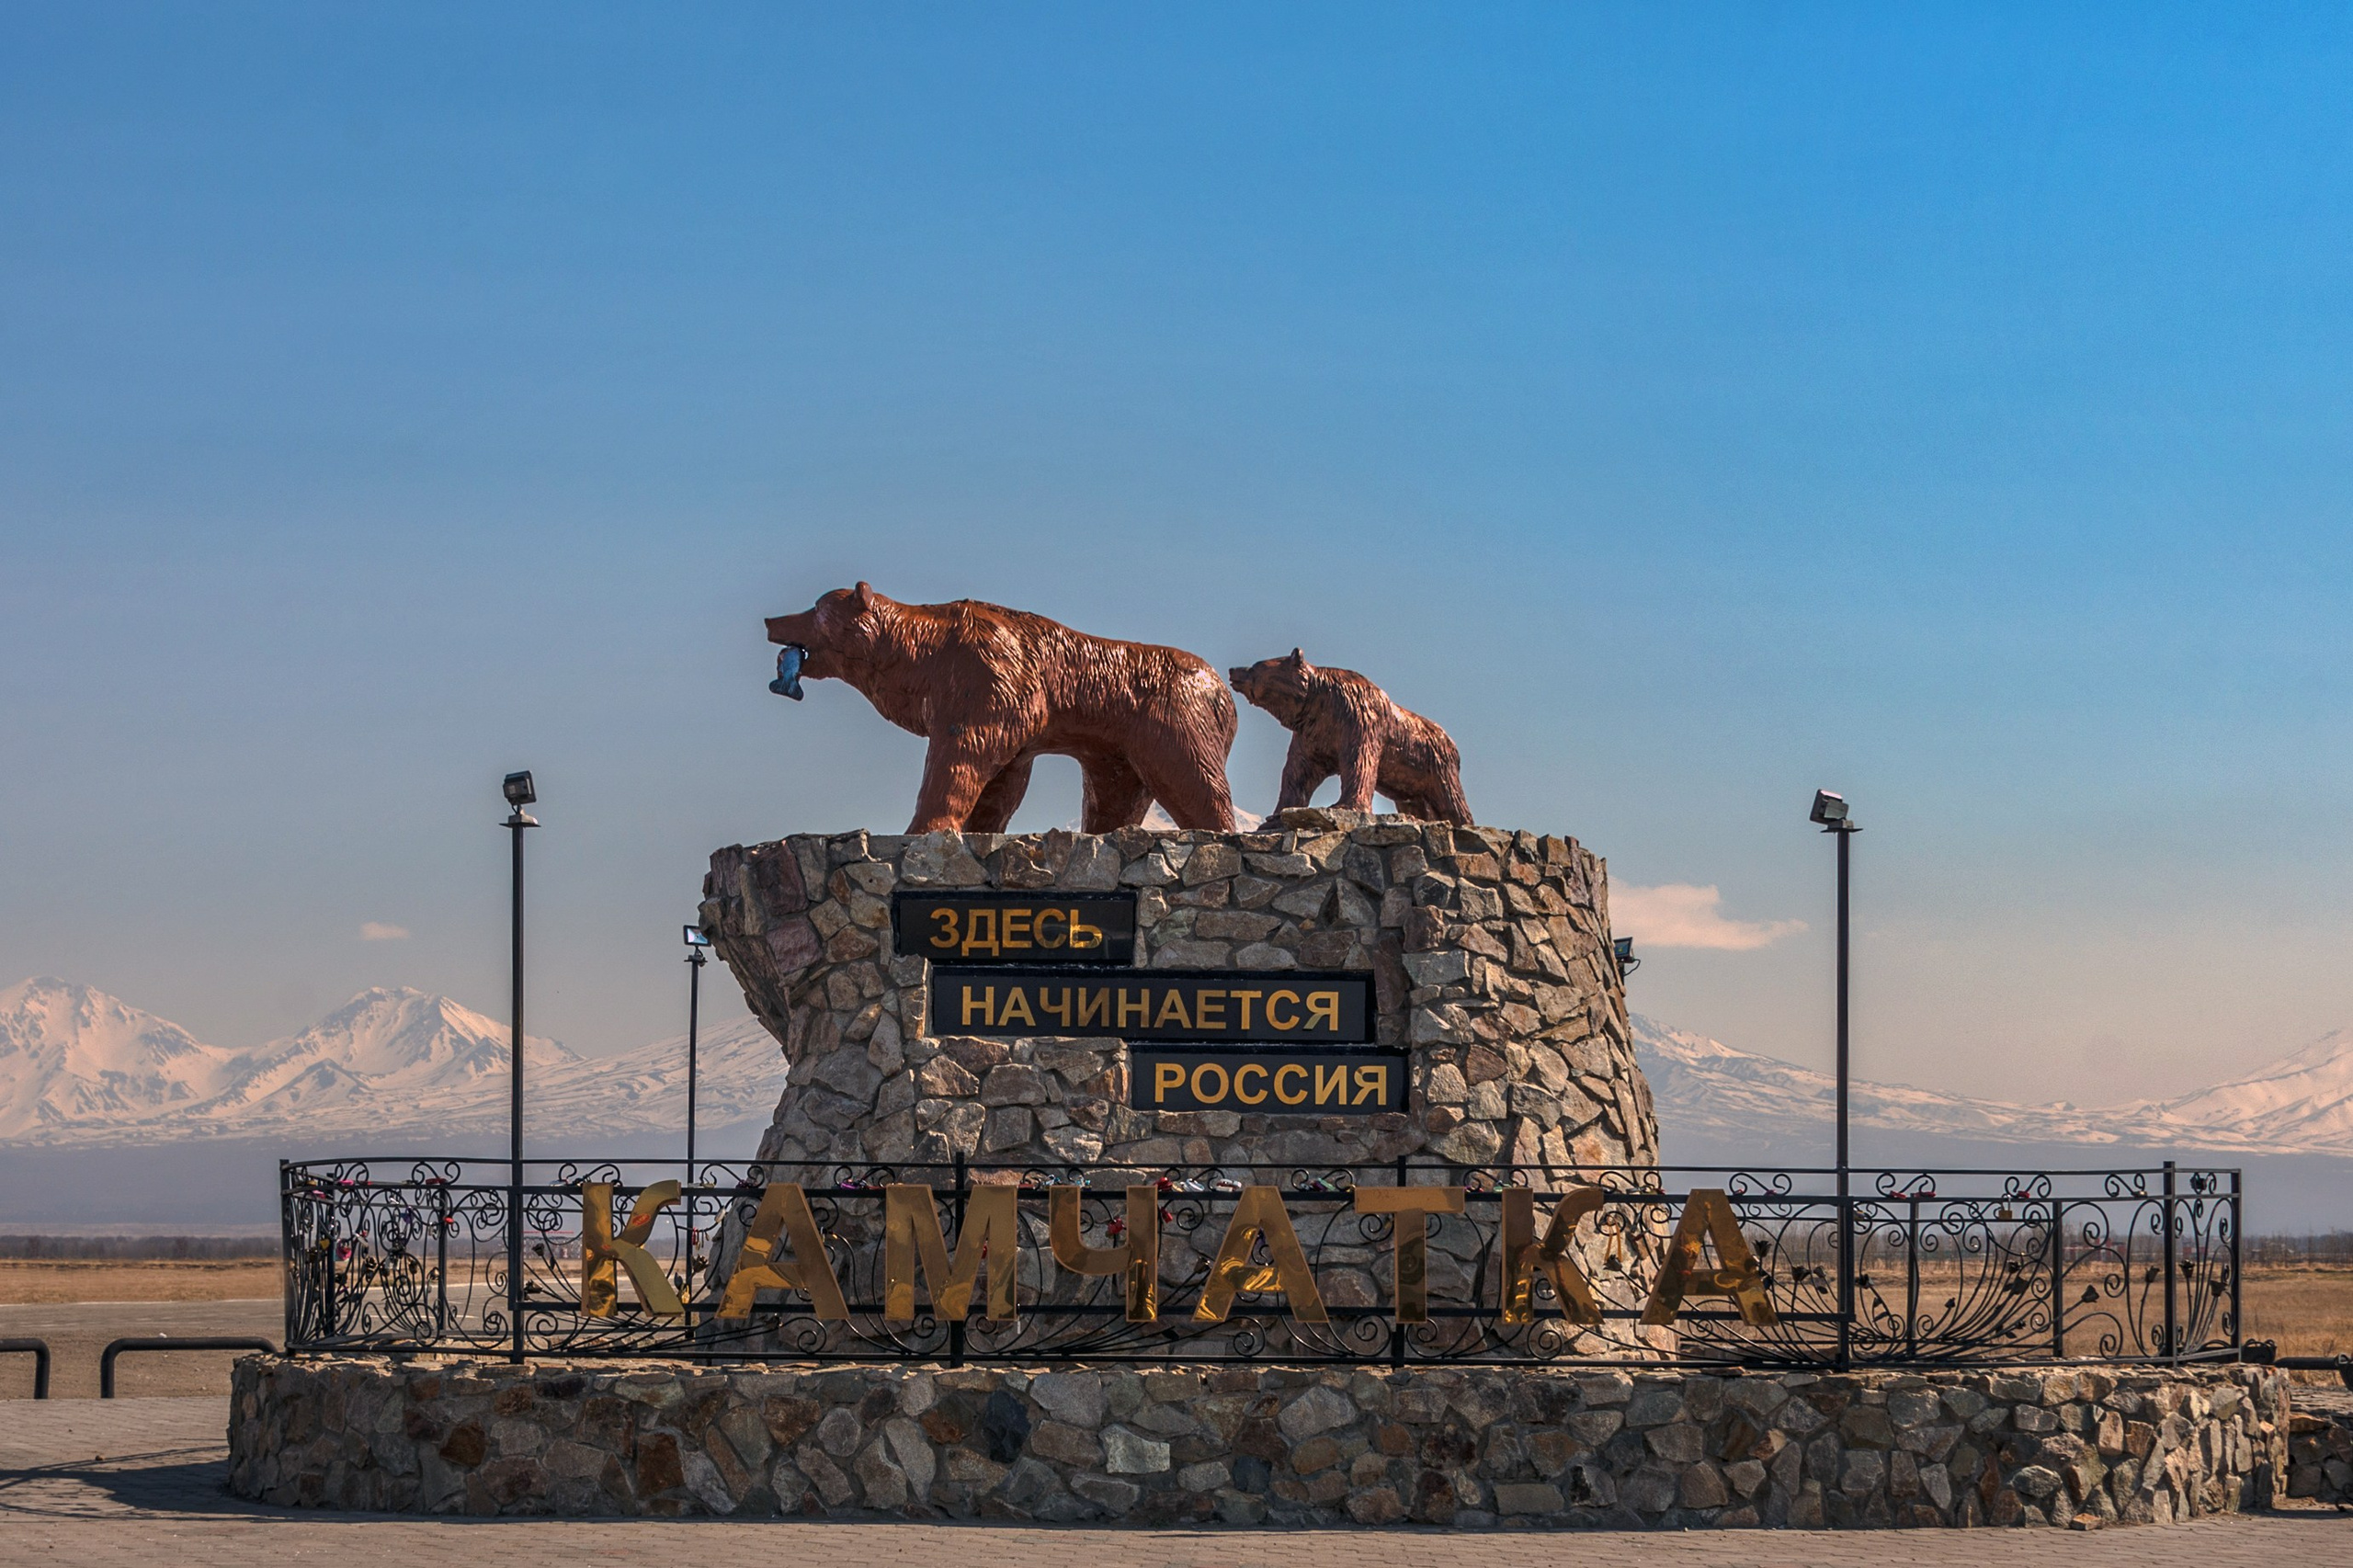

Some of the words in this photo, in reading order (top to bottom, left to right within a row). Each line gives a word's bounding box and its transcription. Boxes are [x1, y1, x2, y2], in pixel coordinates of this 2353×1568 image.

[929, 907, 1103, 956] ЗДЕСЬ
[961, 985, 1339, 1031] НАЧИНАЕТСЯ
[1154, 1062, 1387, 1106] РОССИЯ
[581, 1179, 1779, 1325] КАМЧАТКА
